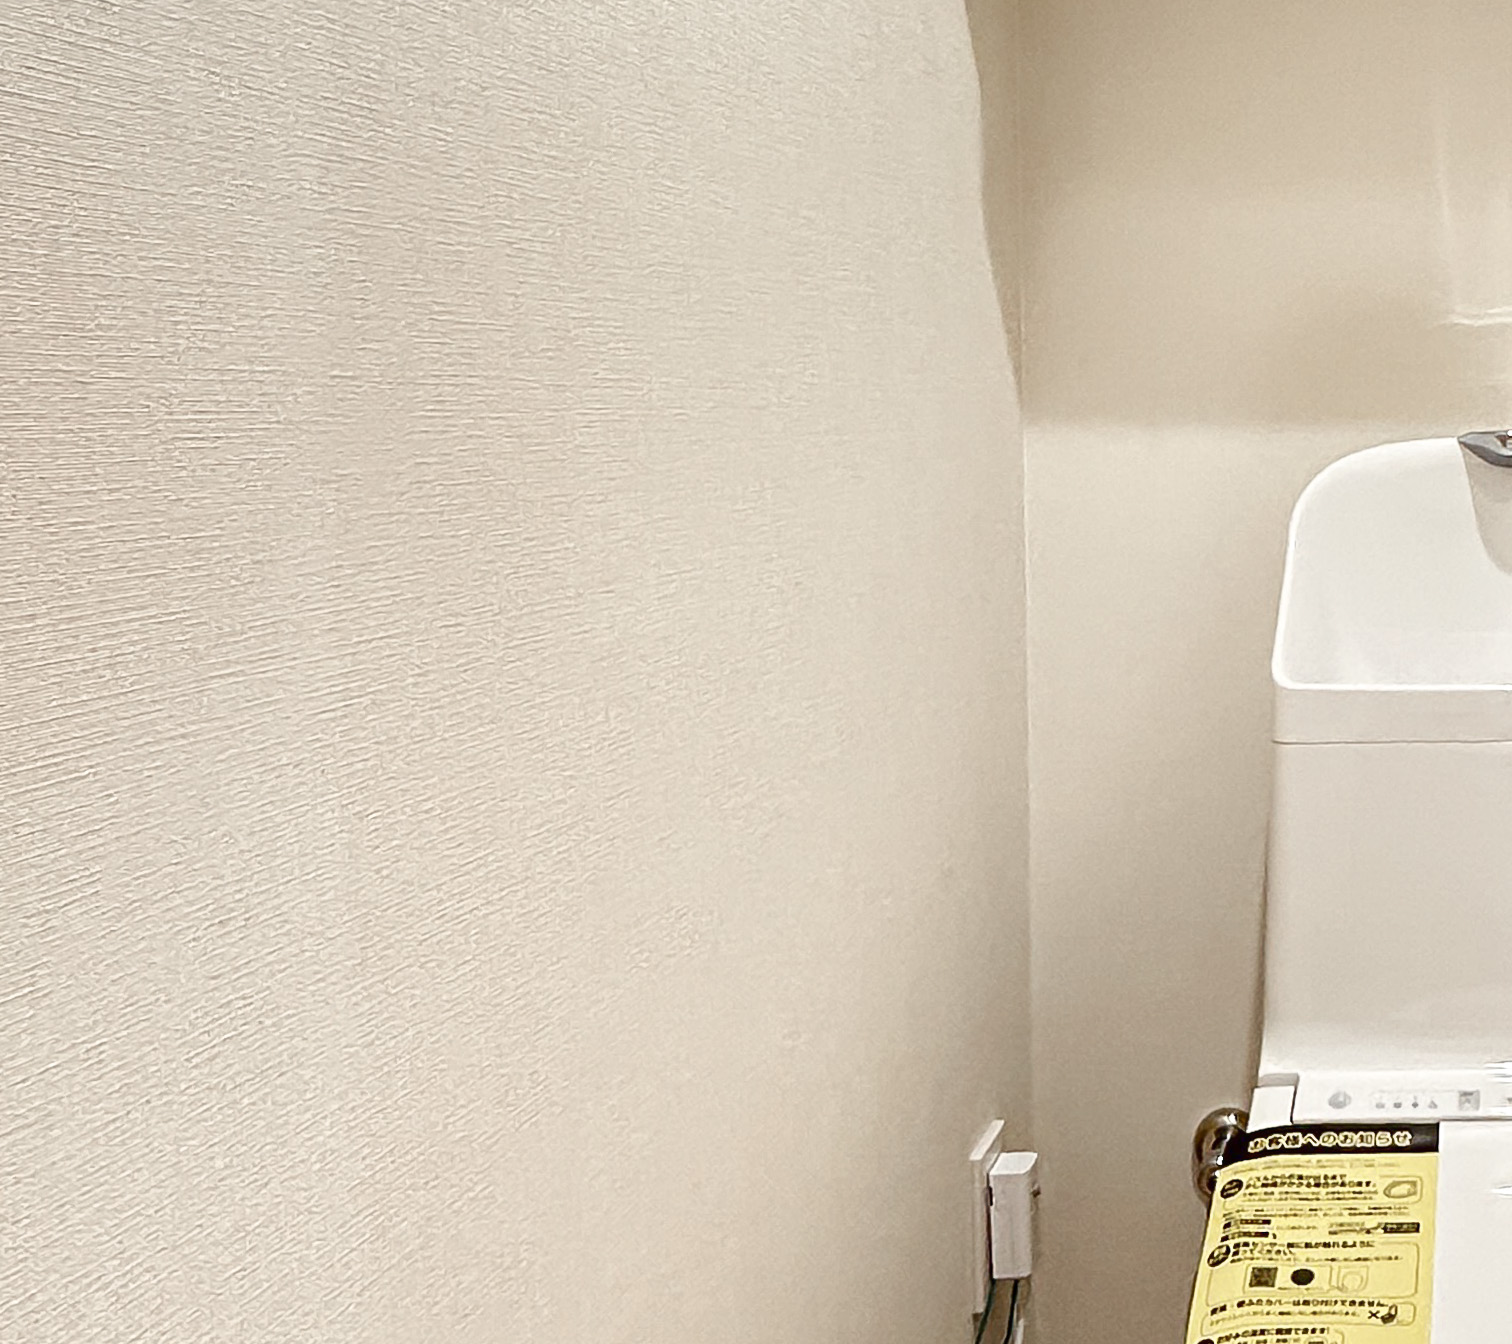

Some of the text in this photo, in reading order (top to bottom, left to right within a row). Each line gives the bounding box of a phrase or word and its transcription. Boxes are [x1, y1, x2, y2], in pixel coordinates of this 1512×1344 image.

[1248, 1131, 1412, 1153] お客様へのお知らせ
